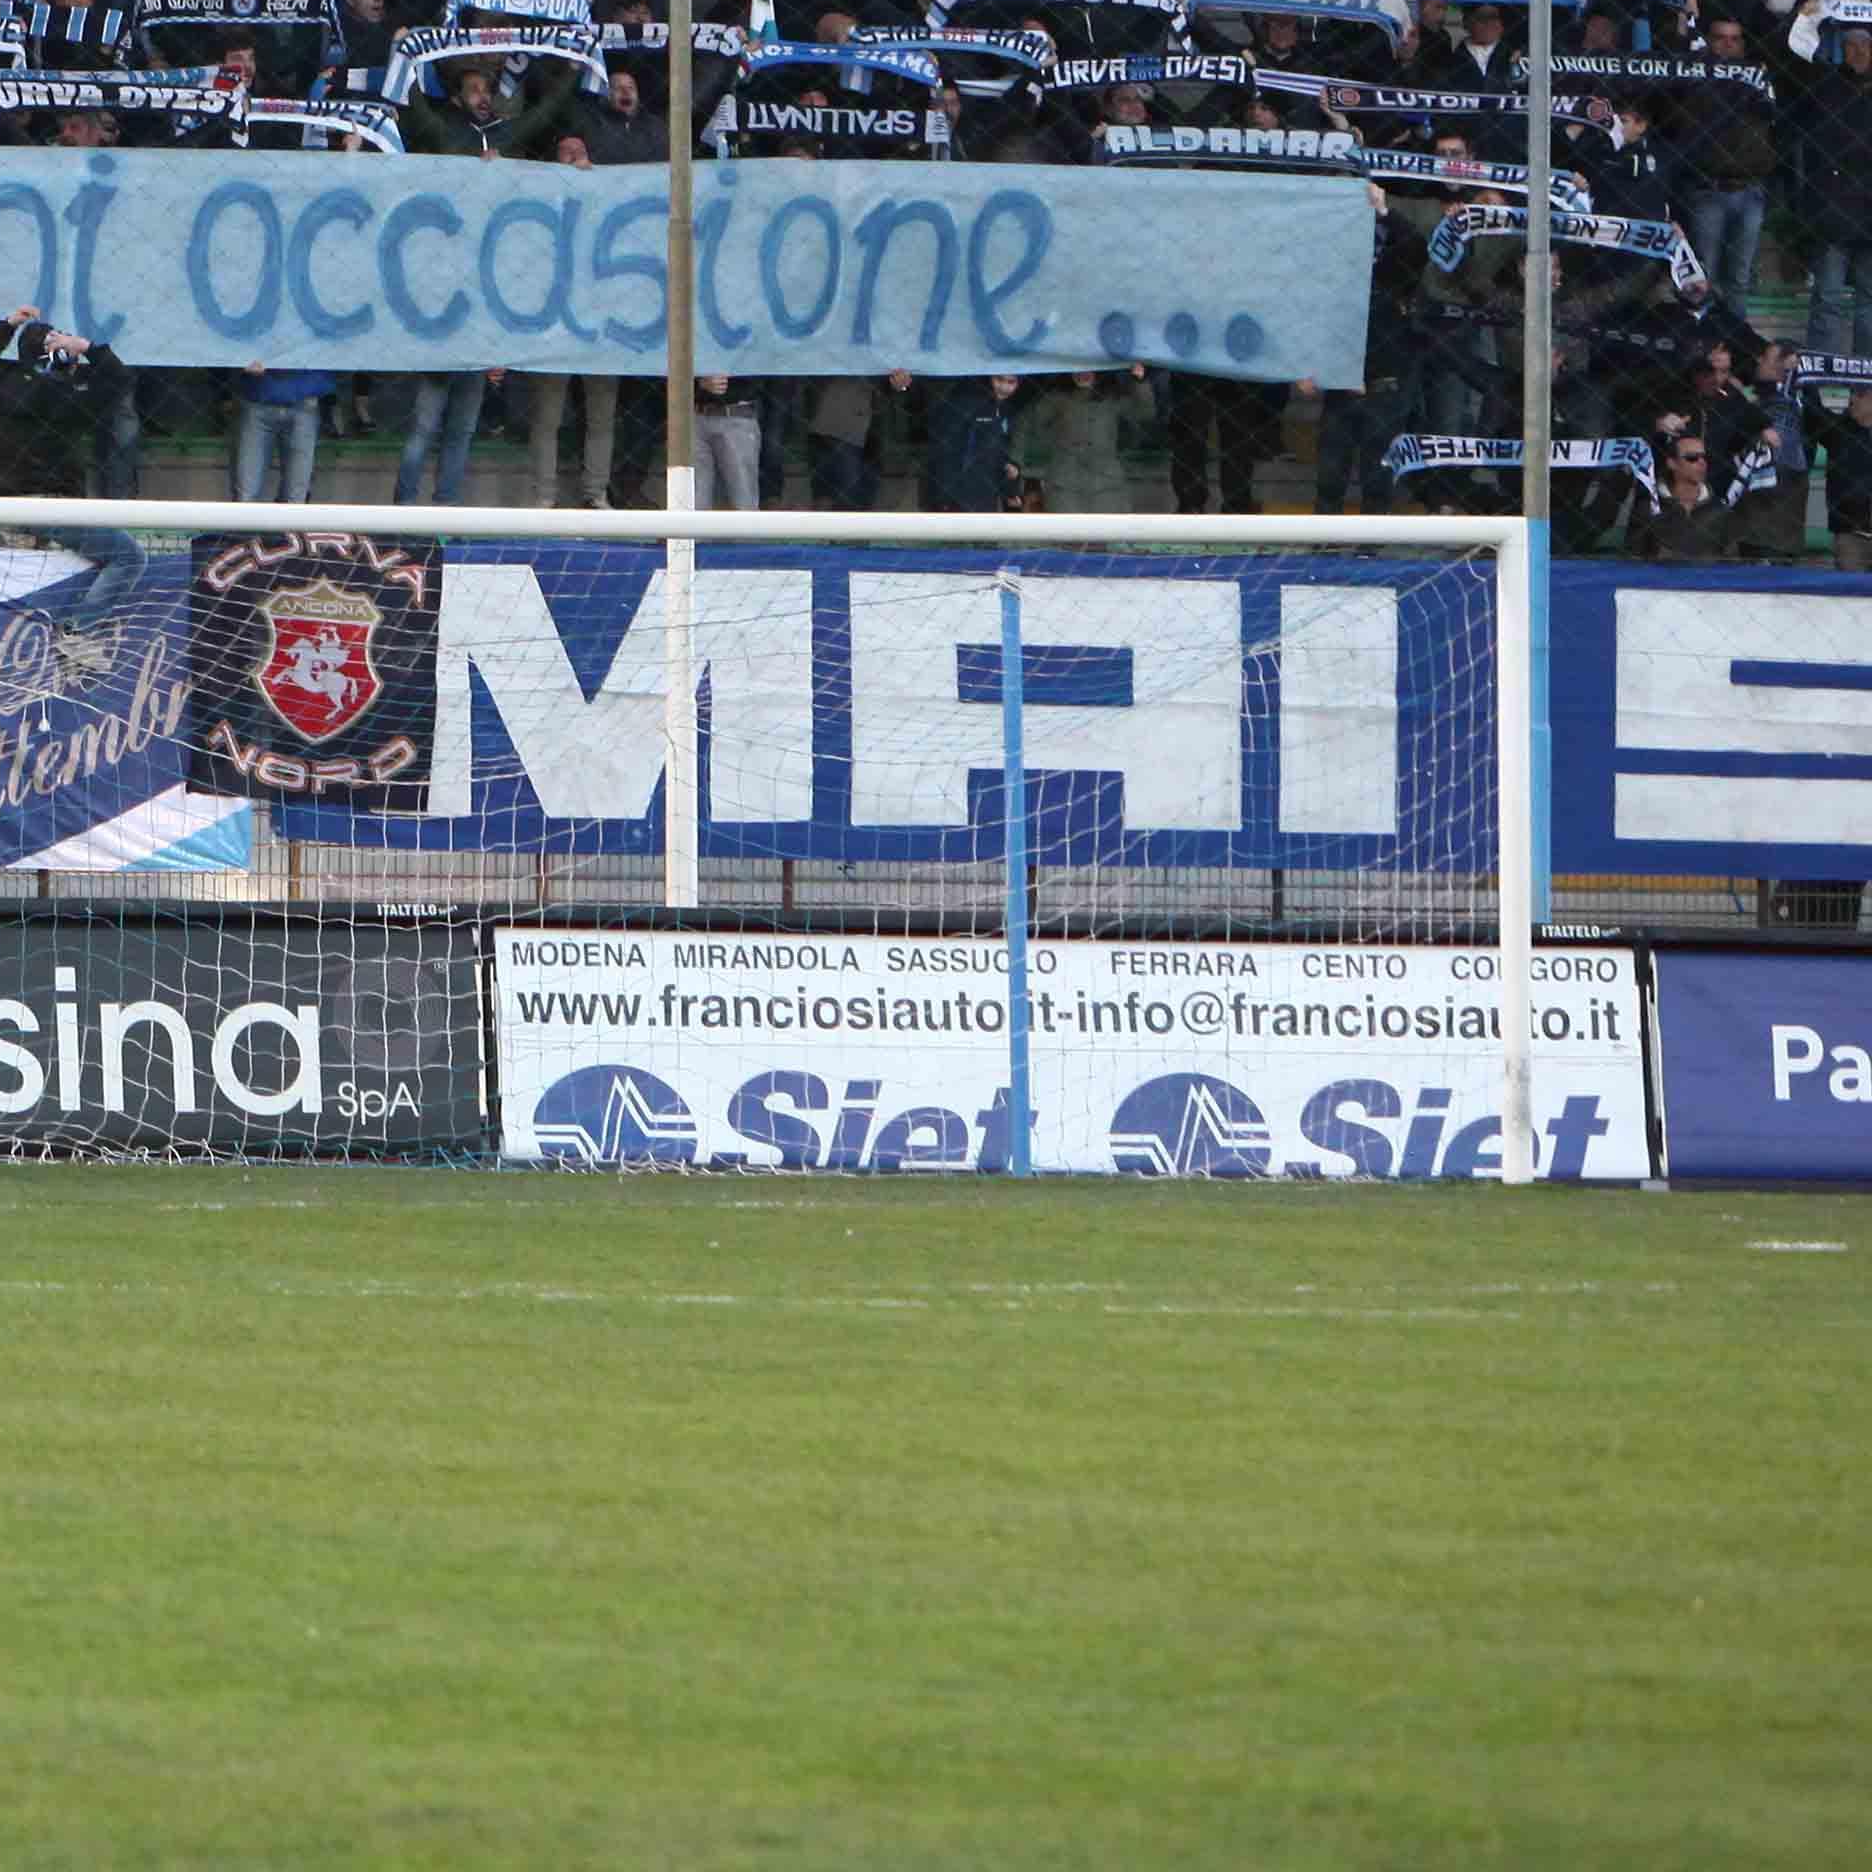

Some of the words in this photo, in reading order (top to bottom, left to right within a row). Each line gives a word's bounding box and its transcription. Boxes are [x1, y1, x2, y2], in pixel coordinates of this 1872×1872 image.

[1626, 60, 1670, 78] CON
[1677, 61, 1708, 79] LA
[1374, 89, 1480, 110] LUTON
[747, 105, 917, 136] SPALLINATI
[1108, 125, 1354, 158] ALDAMAR
[205, 528, 430, 608] CURVA
[277, 596, 368, 619] ANCONA
[208, 716, 417, 796] NORD
[376, 903, 438, 918] ITALTELO
[1541, 924, 1602, 939] ITALTELO
[511, 941, 646, 970] MODENA
[672, 942, 859, 972] MIRANDOLA
[1110, 950, 1259, 978] FERRARA
[1302, 953, 1408, 980] CENTO
[336, 1081, 421, 1126] SpA
